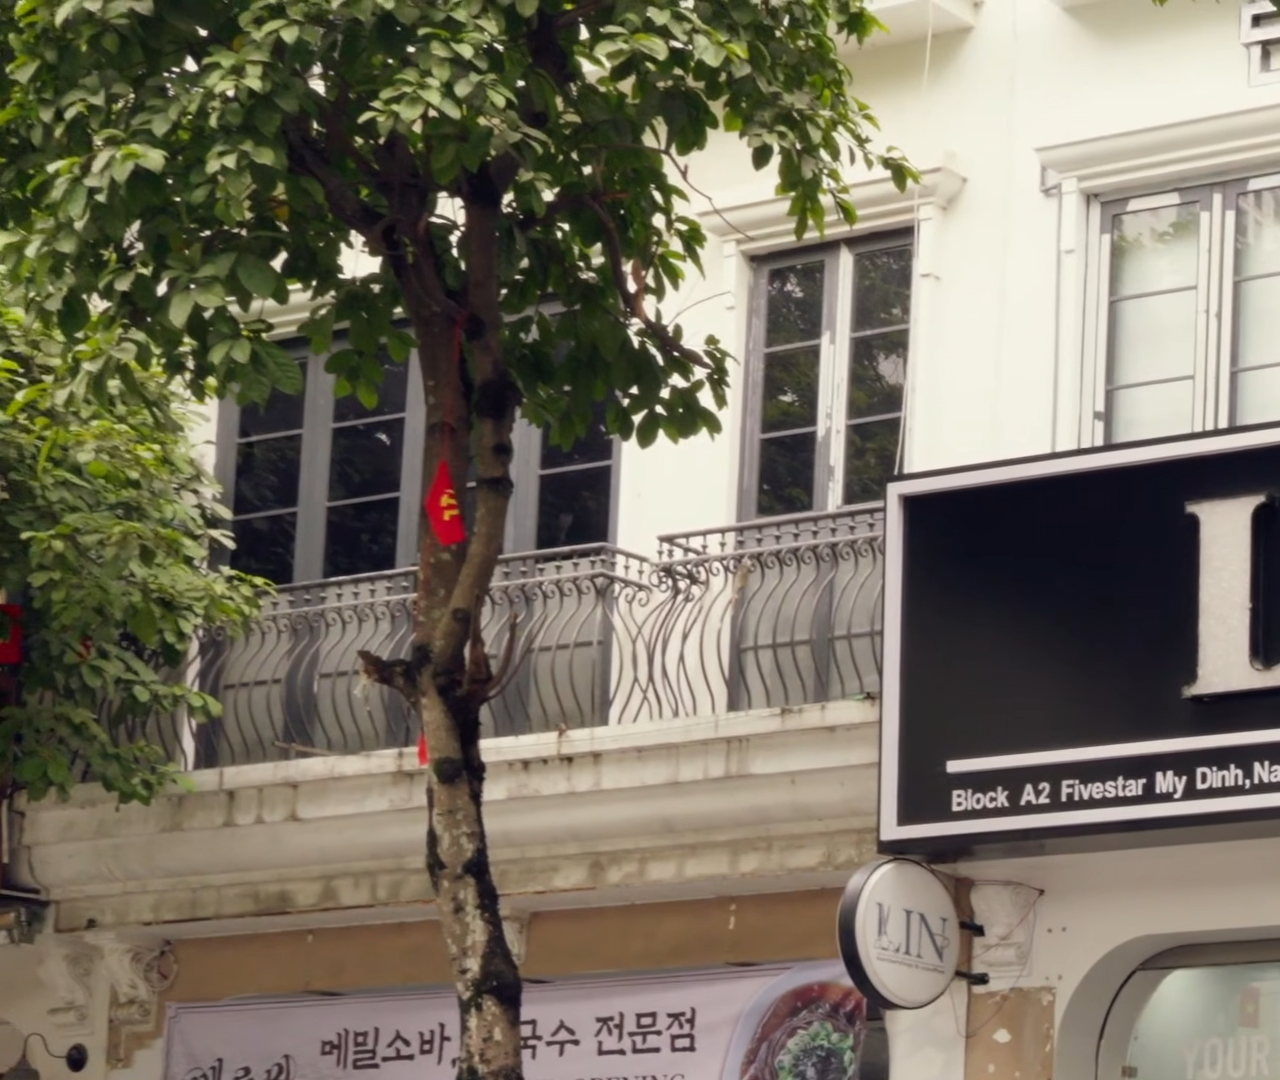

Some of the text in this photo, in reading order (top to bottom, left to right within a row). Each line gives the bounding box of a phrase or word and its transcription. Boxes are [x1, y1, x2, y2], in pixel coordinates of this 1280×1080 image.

[951, 785, 1009, 812] Block
[1020, 782, 1050, 807] A2
[1061, 773, 1146, 802] Fivestar
[1155, 769, 1187, 798] My
[876, 902, 948, 963] LIN
[594, 1007, 698, 1057] 전문점
[1182, 1035, 1270, 1080] YOUR
